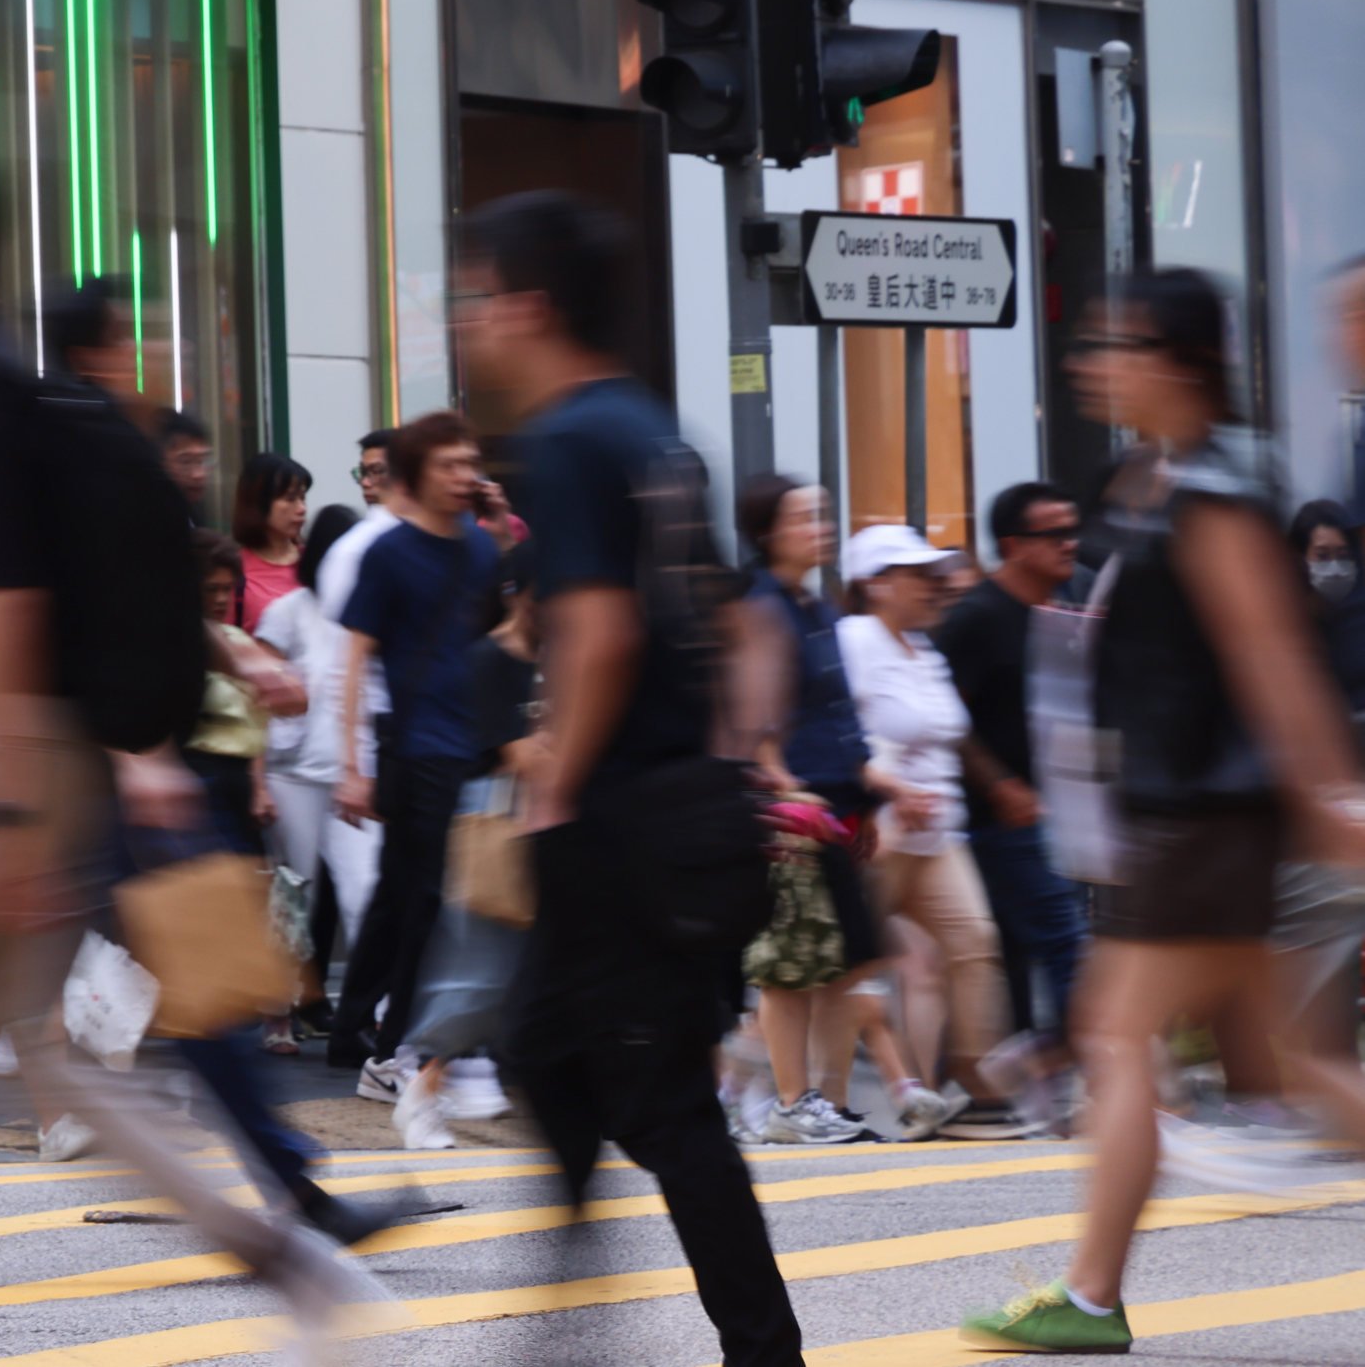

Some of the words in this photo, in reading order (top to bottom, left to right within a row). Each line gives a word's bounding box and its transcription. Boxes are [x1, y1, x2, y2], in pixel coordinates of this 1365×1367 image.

[836, 230, 889, 258] Queen's
[895, 232, 928, 259] Road
[934, 234, 982, 261] Central
[867, 272, 956, 311] 皇后大道中
